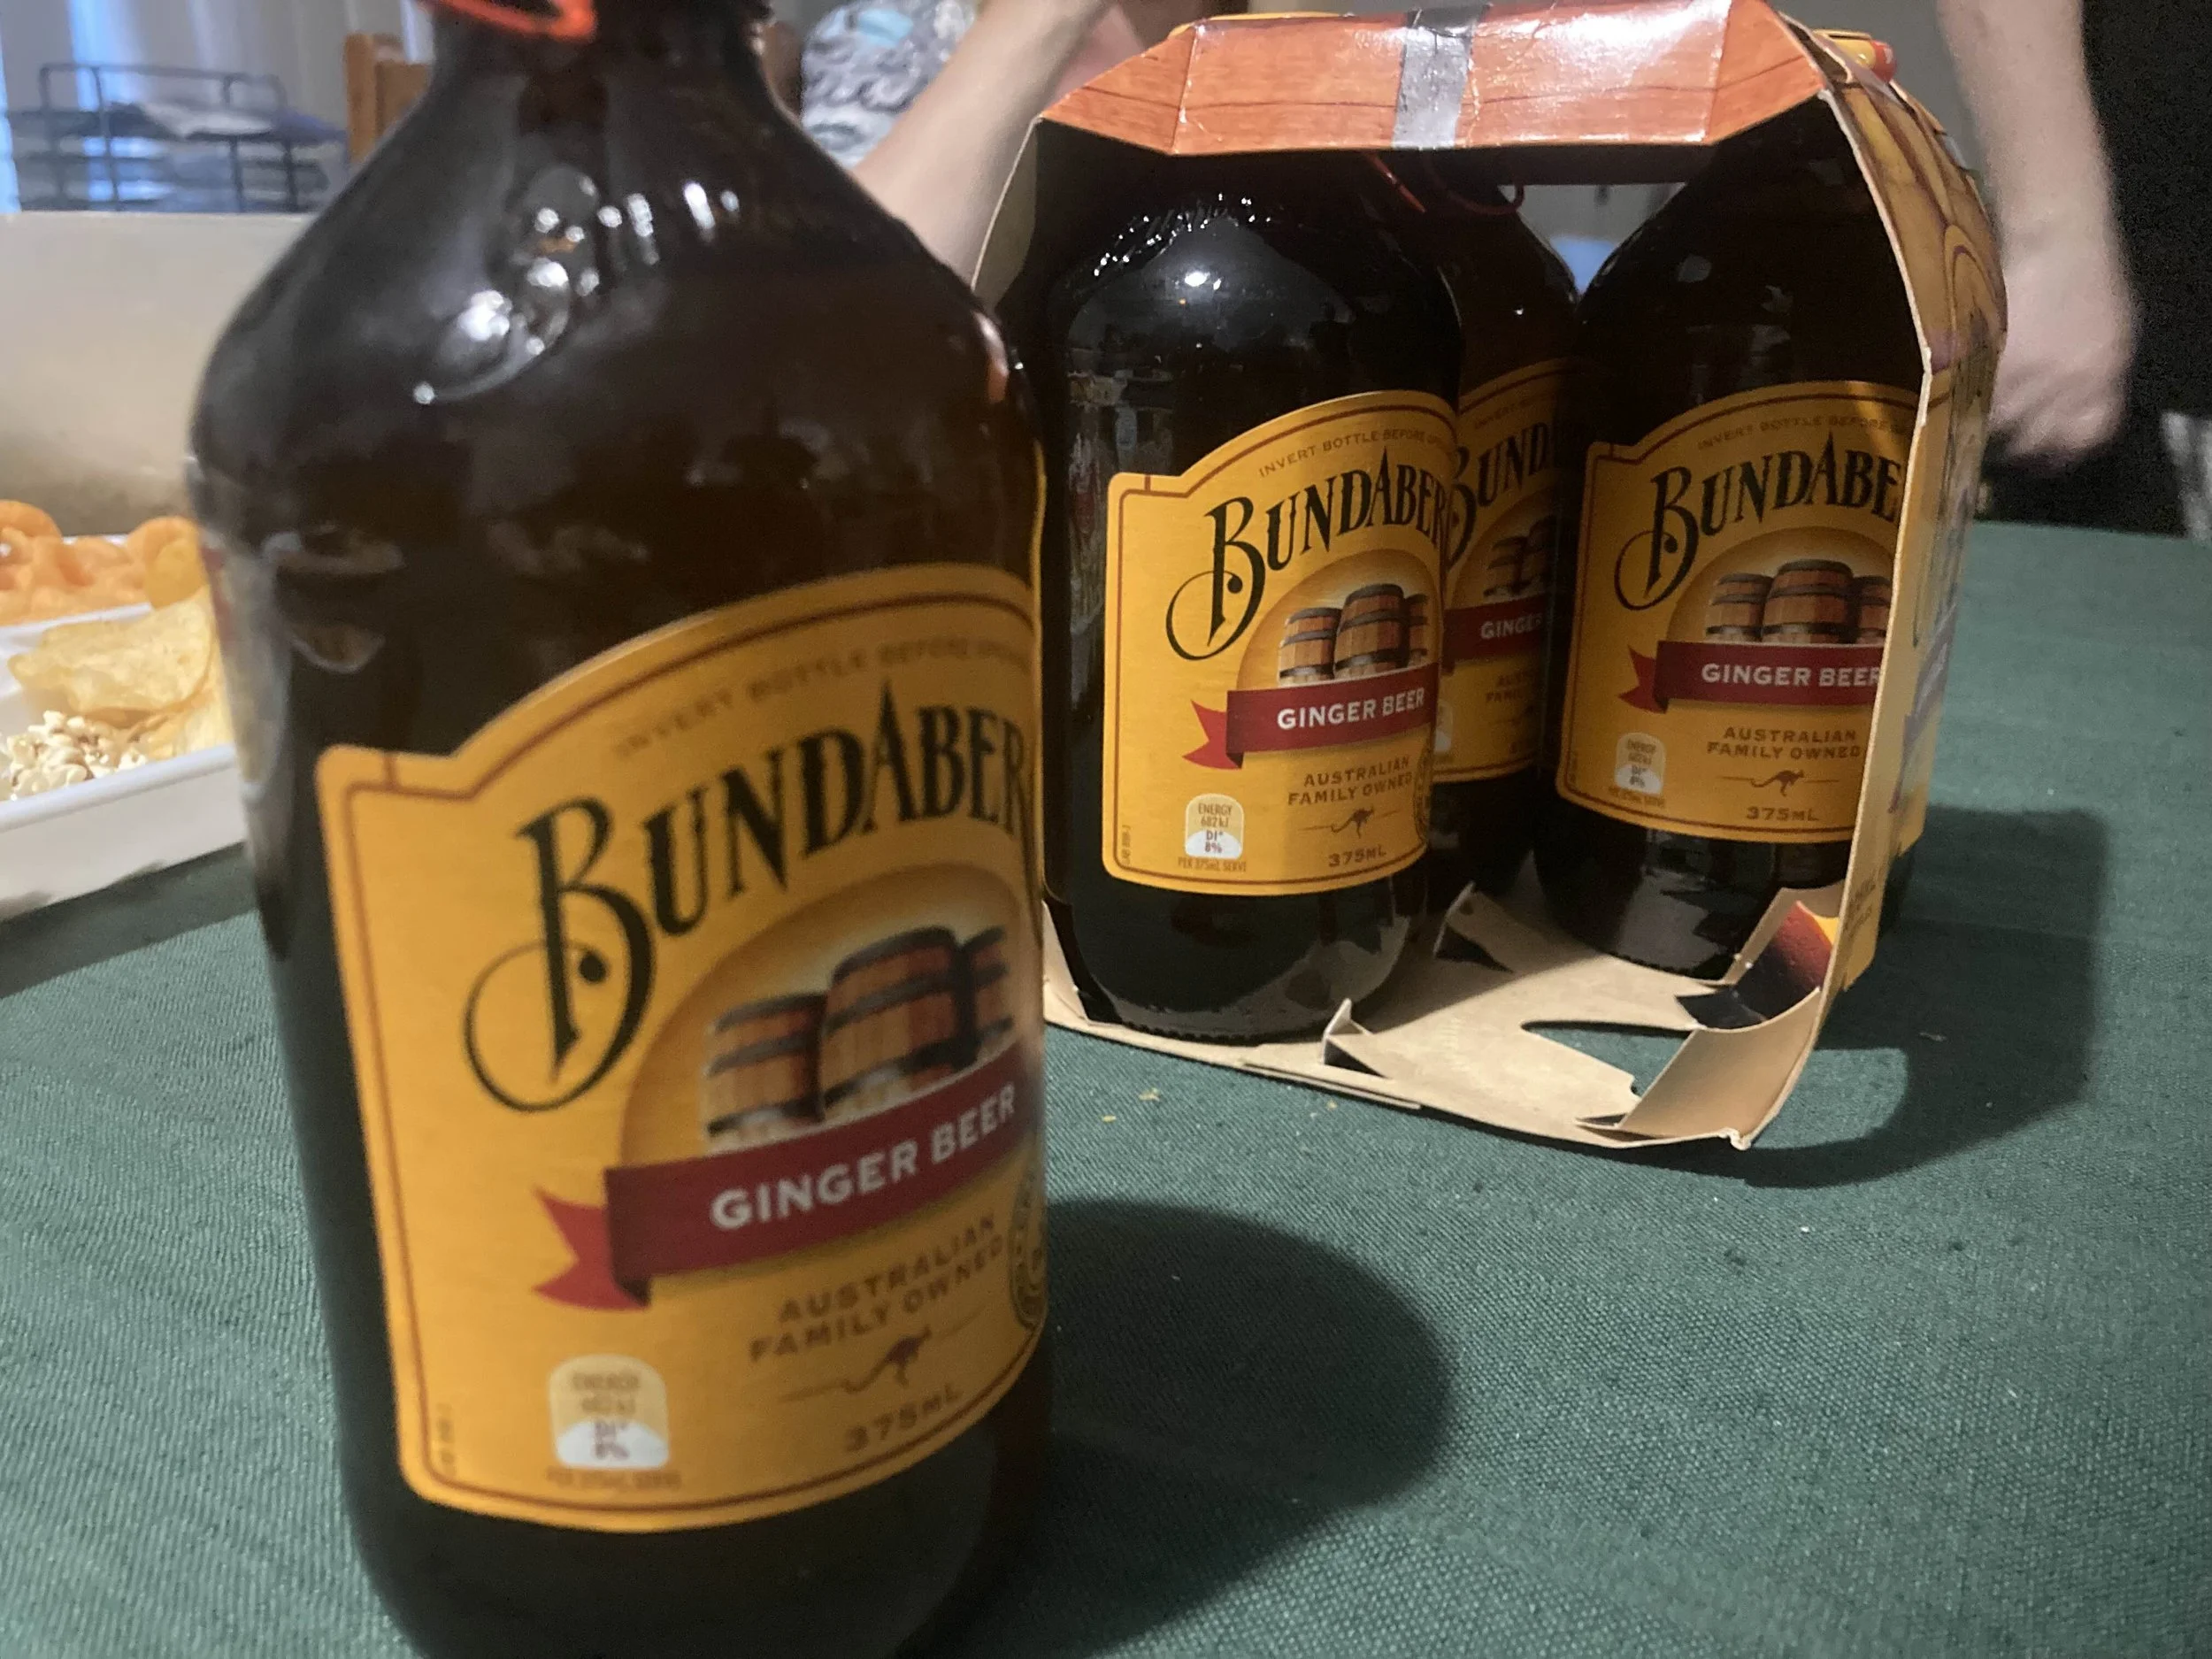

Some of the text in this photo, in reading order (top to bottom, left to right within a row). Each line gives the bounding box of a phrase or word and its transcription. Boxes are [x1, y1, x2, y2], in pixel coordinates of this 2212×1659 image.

[1258, 445, 1317, 479] INVERT
[1322, 429, 1379, 452] BOTTLE
[1701, 663, 1881, 687] GINGER BEER
[1277, 687, 1425, 731] GINGER BEER
[1706, 741, 1861, 760] FAMILY OWNED
[1723, 726, 1856, 744] AUSTRALIAN
[1303, 756, 1410, 787] AUSTRALIAN
[1287, 772, 1413, 807] FAMILY OWNED
[1197, 803, 1233, 817] ENERGY
[1204, 841, 1224, 854] 8%
[711, 1082, 1018, 1231] GINGER BEER
[777, 1210, 996, 1323] AUSTRALIAN
[748, 1302, 893, 1363] FAMILY
[902, 1234, 1004, 1315] OWNED
